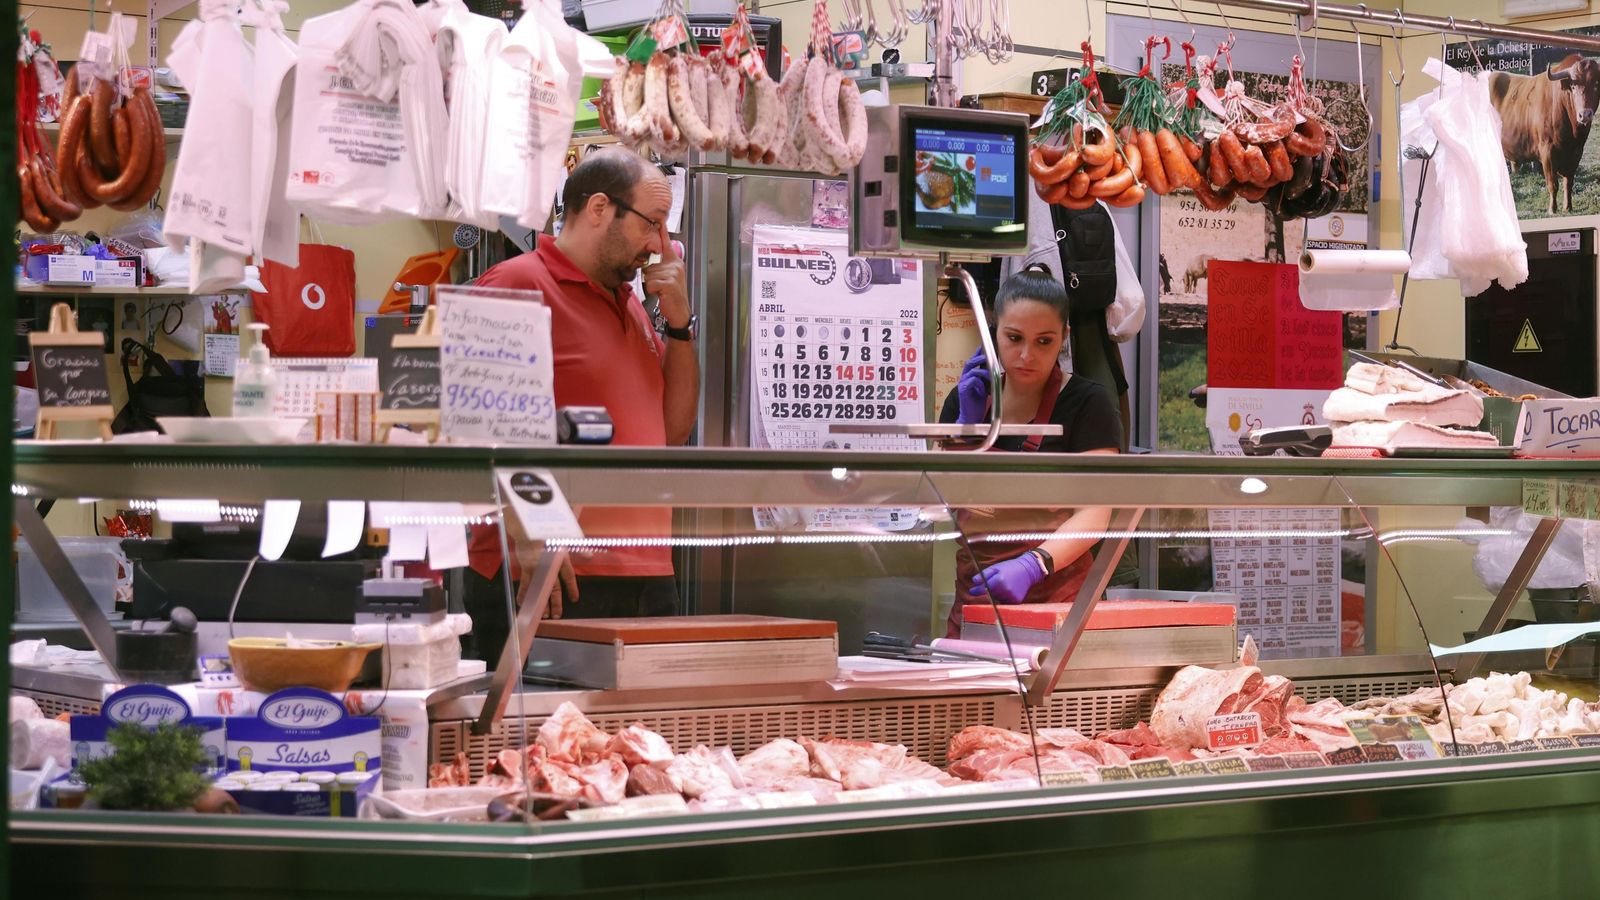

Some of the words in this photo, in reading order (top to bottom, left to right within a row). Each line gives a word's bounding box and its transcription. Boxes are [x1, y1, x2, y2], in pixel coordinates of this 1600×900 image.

[1447, 48, 1455, 60] El
[1457, 48, 1473, 62] Rey
[1476, 45, 1486, 57] de
[1487, 44, 1495, 55] la
[1497, 41, 1528, 54] Dehesa
[1485, 60, 1496, 72] de
[1498, 58, 1531, 72] Badajoz
[1180, 201, 1196, 212] 954
[1178, 217, 1195, 228] 652
[1197, 218, 1208, 229] 81
[1211, 219, 1222, 230] 35
[1224, 220, 1236, 230] 29
[1306, 240, 1328, 249] ESPACIO
[1329, 242, 1365, 250] HIGIENIZADO
[758, 257, 830, 271] BULNES
[82, 271, 93, 281] M
[759, 304, 785, 314] ABRIL
[900, 310, 919, 320] 2022
[761, 329, 767, 337] 13
[862, 328, 868, 342] 1
[882, 328, 891, 342] 2
[903, 329, 912, 343] 3
[43, 350, 100, 368] Gracias
[775, 344, 783, 358] 4
[796, 345, 805, 359] 5
[819, 345, 828, 360] 6
[840, 346, 849, 360] 7
[861, 346, 870, 361] 8
[882, 347, 891, 362] 9
[900, 348, 916, 362] 10
[60, 369, 84, 385] por
[761, 368, 767, 376] 15
[772, 364, 785, 378] 11
[793, 364, 810, 379] 12
[815, 365, 831, 379] 13
[836, 365, 853, 380] 14
[858, 366, 874, 380] 15
[879, 366, 895, 381] 16
[899, 367, 916, 381] 17
[772, 383, 786, 398] 18
[792, 384, 810, 399] 19
[813, 384, 832, 399] 20
[836, 385, 852, 399] 21
[856, 385, 874, 400] 22
[877, 386, 895, 400] 23
[898, 386, 917, 400] 24
[771, 403, 789, 418] 25
[792, 403, 811, 418] 26
[814, 404, 832, 418] 27
[835, 404, 853, 419] 28
[856, 405, 874, 419] 29
[877, 405, 896, 419] 30
[1543, 406, 1600, 435] TOCAR
[119, 704, 136, 717] El
[136, 700, 179, 724] Guijo
[276, 703, 293, 718] El
[293, 702, 331, 725] Guijo
[267, 744, 331, 765] Salsas
